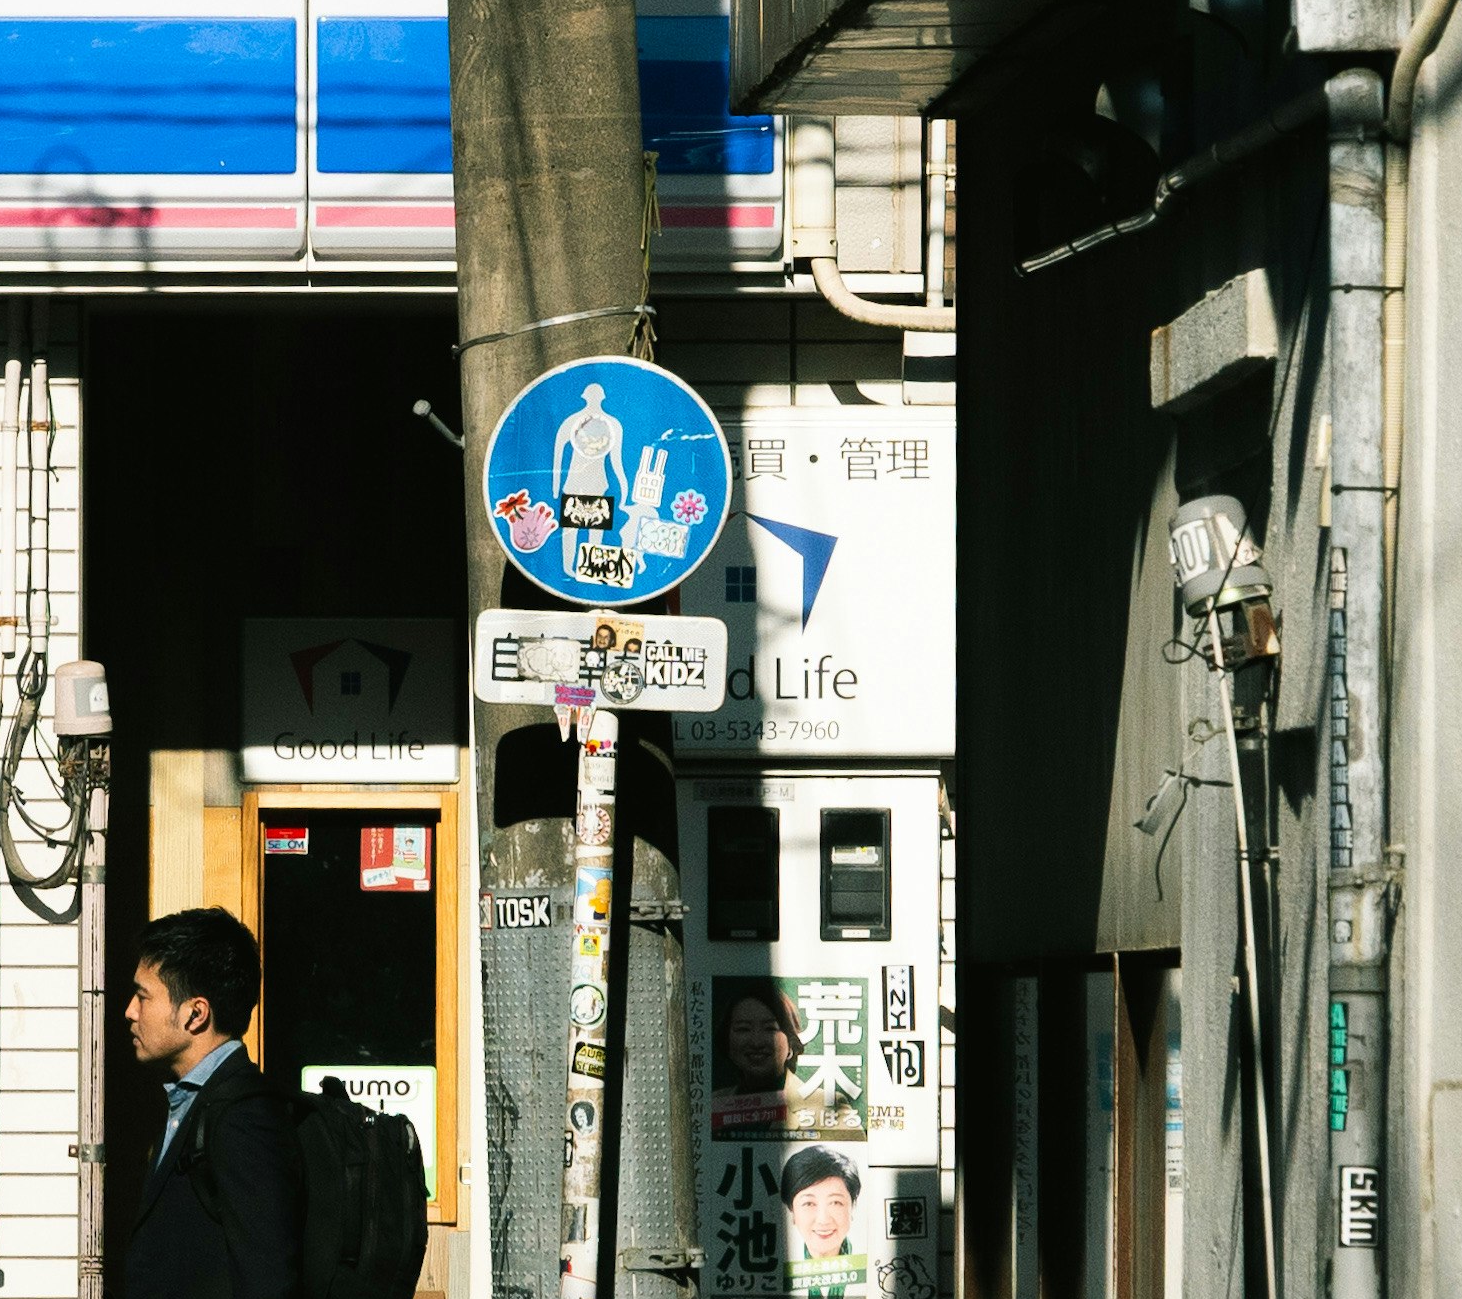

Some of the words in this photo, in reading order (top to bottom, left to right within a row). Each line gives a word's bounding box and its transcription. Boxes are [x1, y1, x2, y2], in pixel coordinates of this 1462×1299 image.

[647, 646, 679, 661] CALL
[684, 648, 704, 662] ME
[646, 662, 704, 686] KIDZ
[775, 655, 858, 700] Life
[692, 720, 840, 741] 03-5343-7960
[273, 732, 359, 761] Good
[372, 732, 425, 761] Life
[496, 896, 551, 927] TOSK
[795, 982, 863, 1106] 荒木
[319, 1079, 410, 1096] umo
[795, 1109, 863, 1128] ちはる
[715, 1147, 777, 1274] 小池
[714, 1273, 776, 1292] ゆりこ
